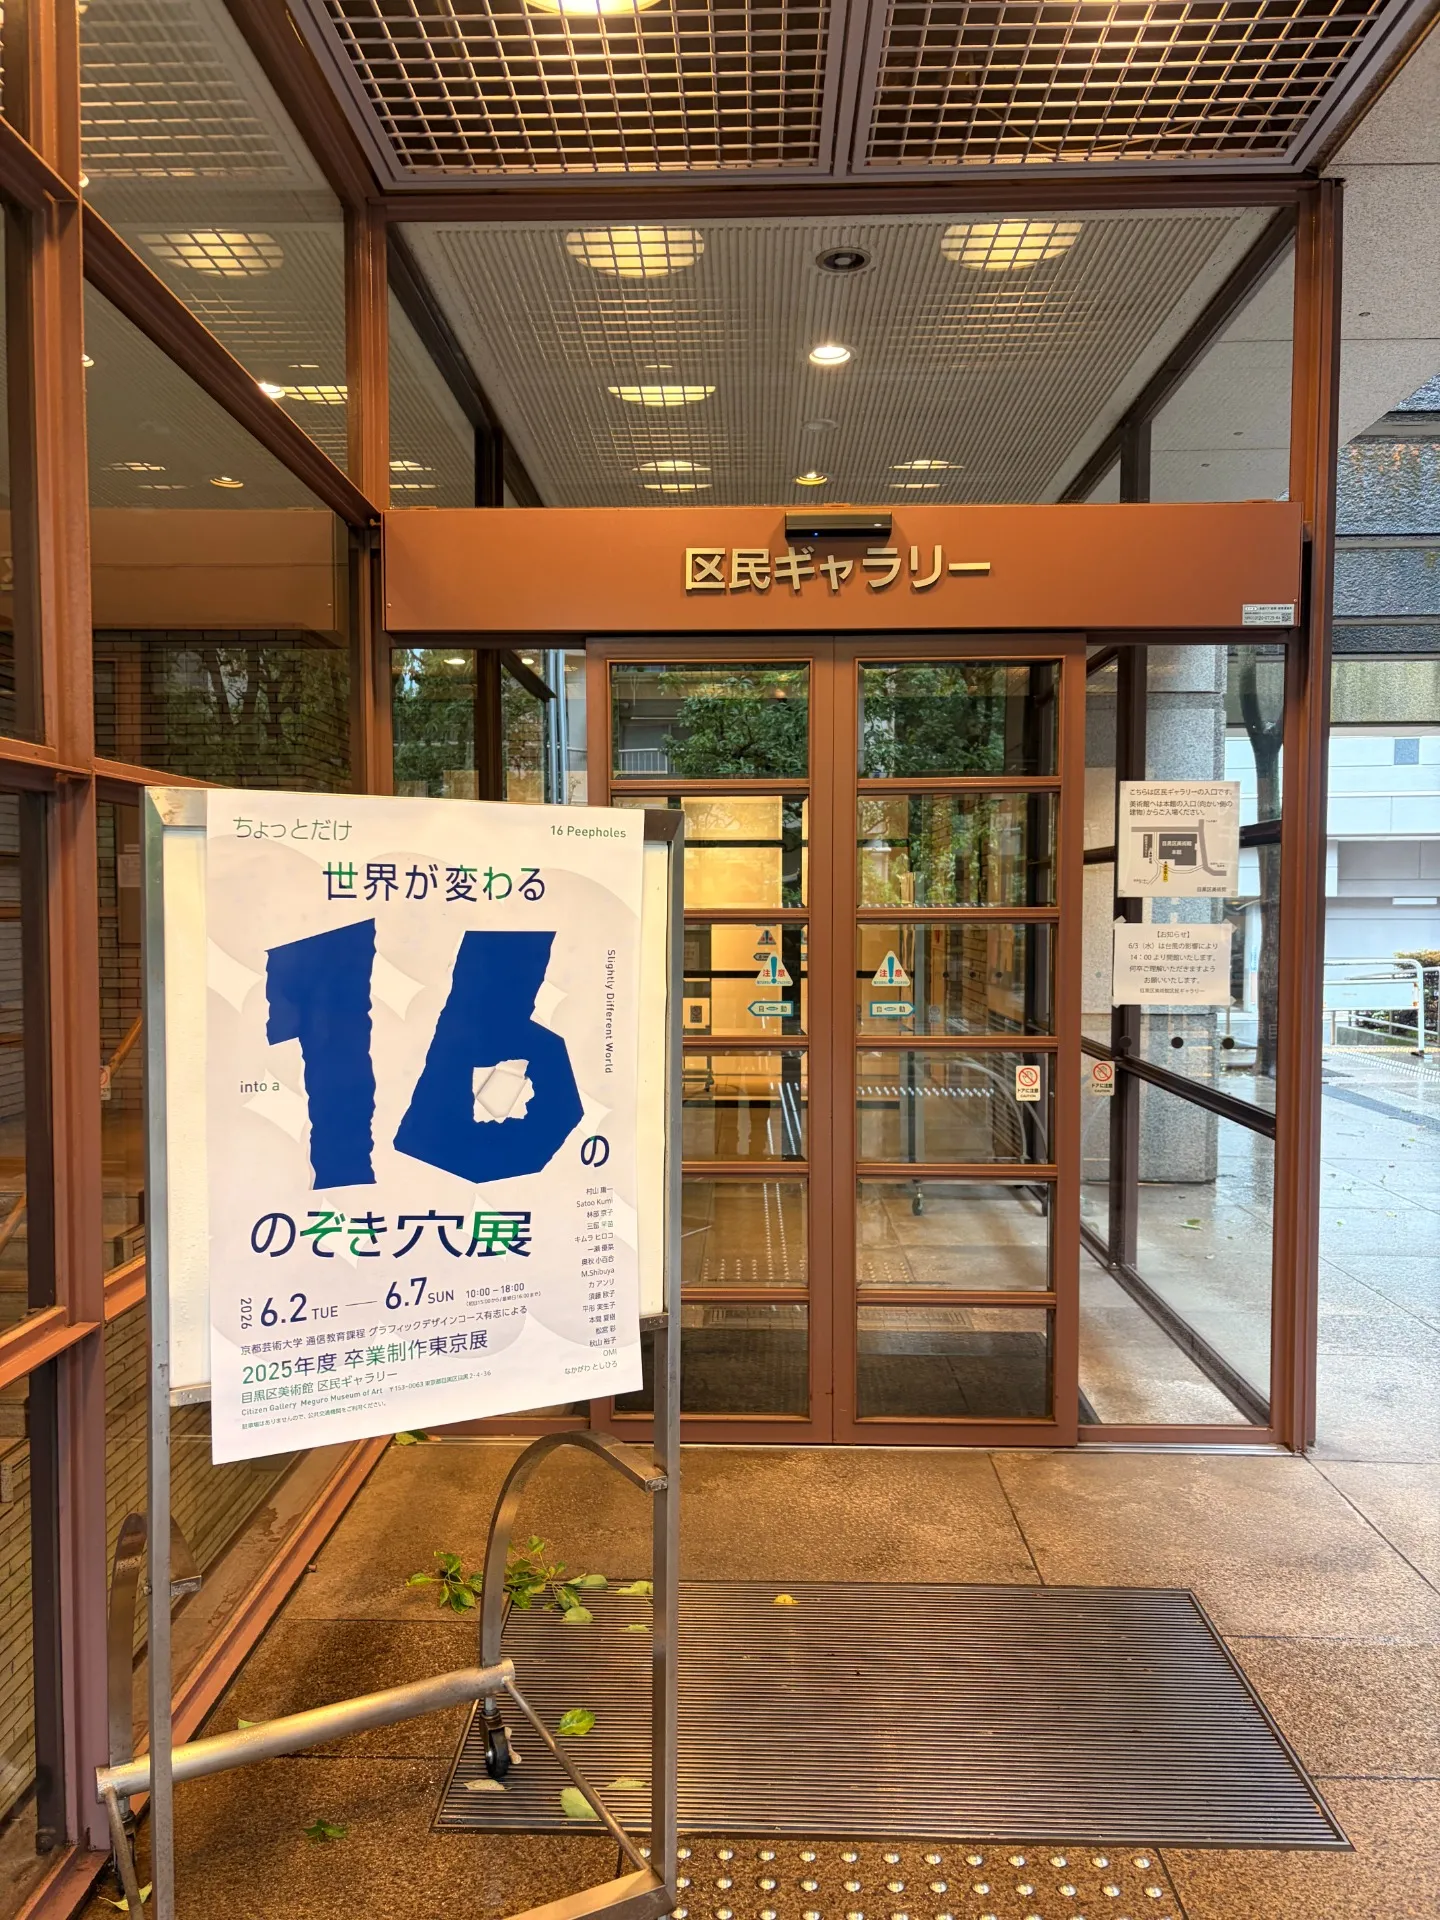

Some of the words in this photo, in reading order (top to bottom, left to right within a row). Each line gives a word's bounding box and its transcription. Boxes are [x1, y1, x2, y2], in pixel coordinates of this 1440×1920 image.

[685, 545, 991, 591] 区民ギャラリー
[1129, 788, 1233, 796] こちらは区民ギャラリーの入口です。
[1129, 800, 1233, 808] 美術館へは本館の入口（向かい側の
[1129, 808, 1206, 816] 建物）からご入場ください。
[233, 817, 353, 841] ちょっとだけ
[550, 825, 564, 837] 16
[566, 825, 627, 839] Peepholes
[322, 861, 546, 902] 世界が変わる
[1157, 931, 1191, 939] 【お知らせ】
[605, 949, 616, 990] Slightly
[605, 993, 615, 1040] Different
[264, 917, 585, 1190] 16
[604, 1042, 614, 1074] World
[239, 1079, 268, 1093] into
[271, 1081, 280, 1092] a
[580, 1135, 610, 1168] の
[576, 1200, 595, 1208] Satoo
[596, 1197, 613, 1205] Kumi
[250, 1210, 532, 1259] のぞき穴展
[574, 1234, 594, 1243] キムラ
[595, 1232, 614, 1241] ヒロコ
[581, 1267, 615, 1277] M.Shibuya
[240, 1297, 253, 1330] 2026
[260, 1292, 307, 1327] 6.2
[311, 1305, 339, 1320] TUE
[385, 1276, 427, 1310] 6.7
[428, 1289, 454, 1304] SUN
[240, 1337, 303, 1356] 京都芸術大学
[305, 1328, 366, 1346] 通信教育課程
[368, 1305, 528, 1336] グラフィックデザインコース有志による
[242, 1352, 338, 1385] 2025年度
[344, 1329, 488, 1369] 卒業制作東京展
[592, 1360, 618, 1371] としひろ
[241, 1381, 314, 1404] 目黒区美術館
[317, 1370, 398, 1392] 区民ギャラリー
[241, 1407, 268, 1416] Citizen
[269, 1401, 297, 1412] Gallery
[300, 1396, 329, 1407] Meguro
[330, 1391, 361, 1401] Museum
[362, 1389, 370, 1397] of
[371, 1387, 383, 1395] Art
